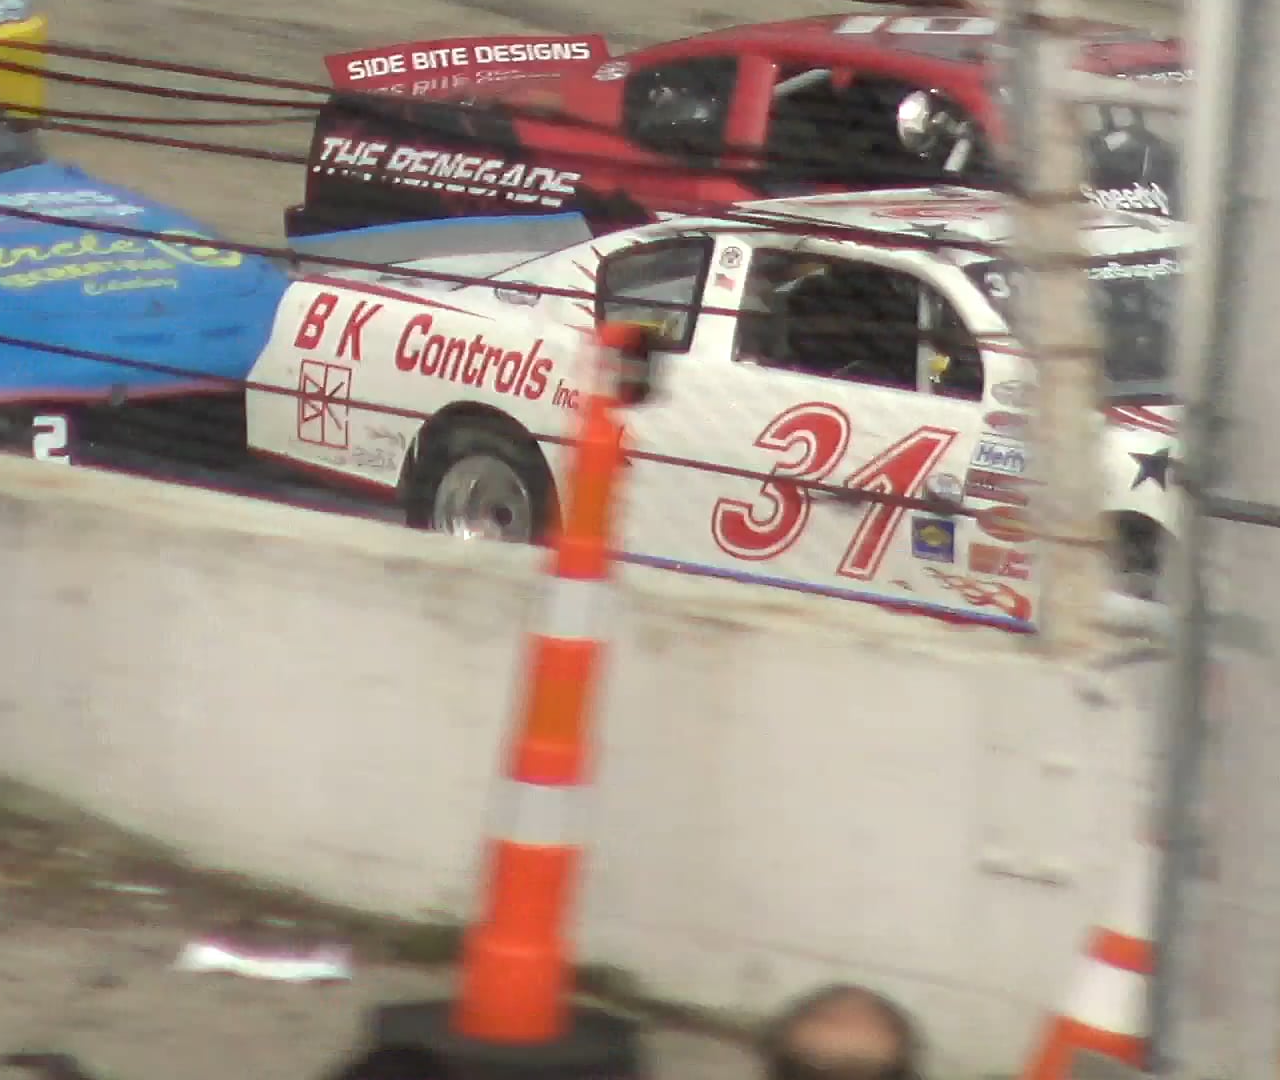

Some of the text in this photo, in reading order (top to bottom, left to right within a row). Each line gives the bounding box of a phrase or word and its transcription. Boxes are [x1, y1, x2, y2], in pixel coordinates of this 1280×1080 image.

[346, 41, 592, 80] SIDE BITE DESIGNS
[294, 292, 338, 351] B
[335, 300, 385, 361] K
[394, 313, 554, 401] Controls
[32, 415, 70, 465] 2
[712, 401, 960, 580] 31
